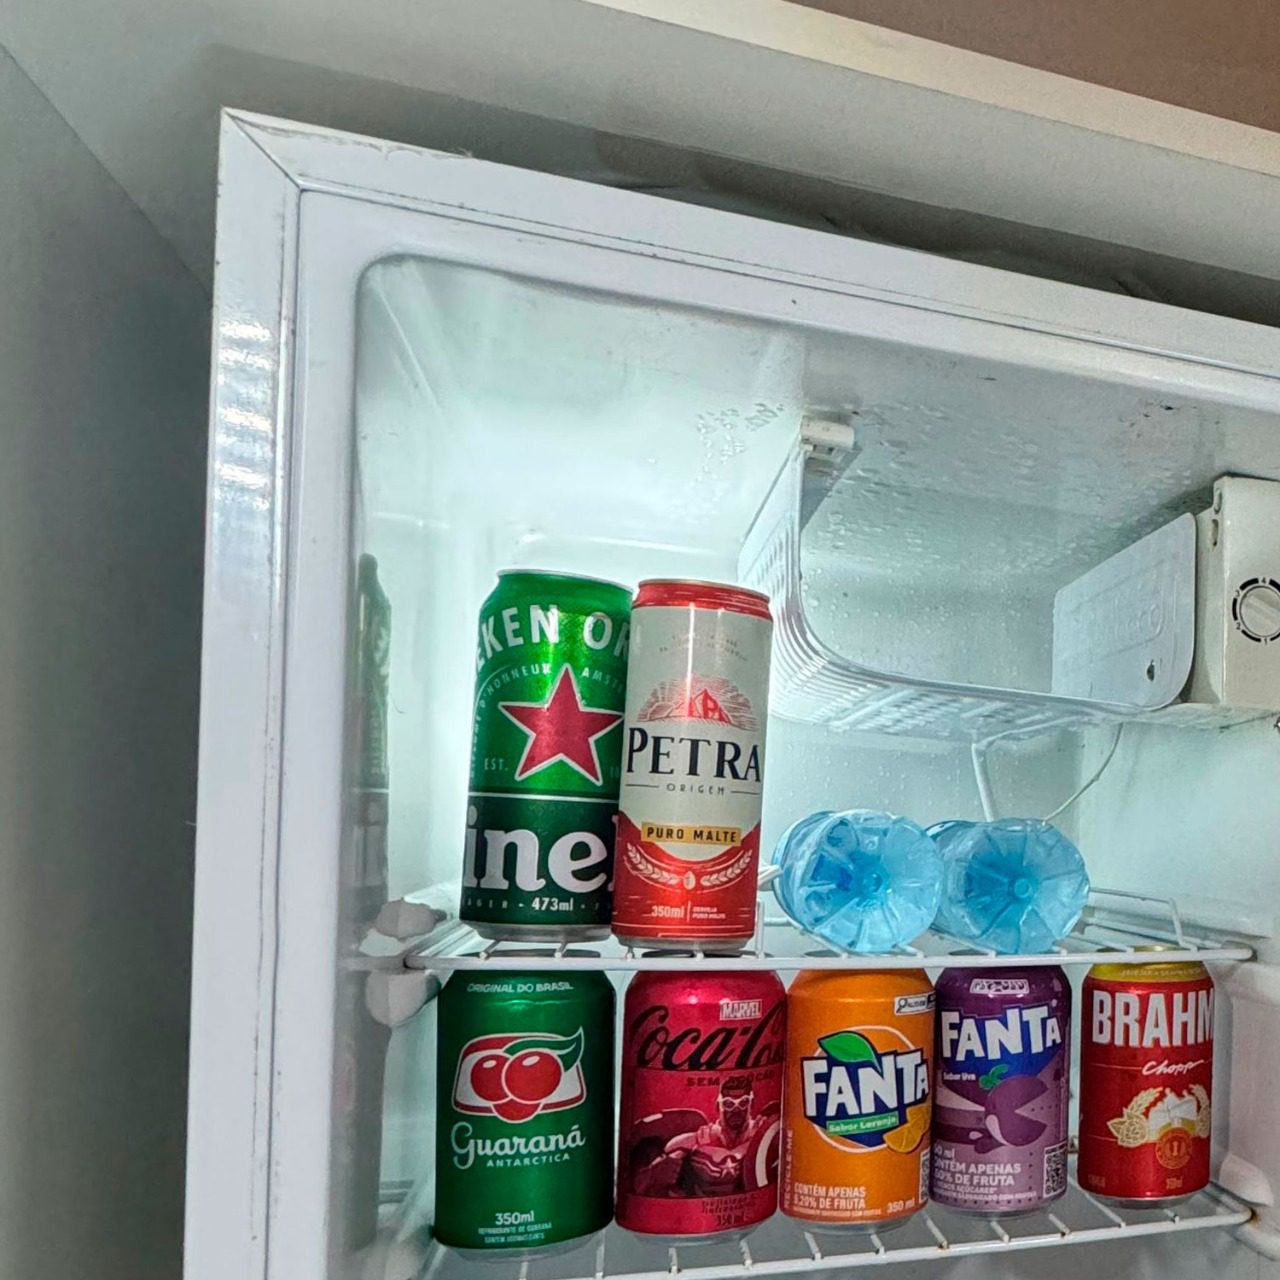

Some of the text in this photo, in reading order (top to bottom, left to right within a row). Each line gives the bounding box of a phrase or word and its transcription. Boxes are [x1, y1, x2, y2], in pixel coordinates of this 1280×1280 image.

[626, 727, 761, 783] PETRA
[484, 758, 509, 772] EST.
[666, 783, 725, 796] ORIGEM
[647, 827, 737, 842] PURO MALTE
[464, 805, 613, 893] ine
[531, 897, 574, 911] 473ml
[651, 905, 685, 918] 350ml
[467, 982, 575, 993] ORIGINAL DO BRASIL
[722, 1002, 761, 1018] MARVEL
[942, 1006, 1061, 1061] FANTA
[1142, 1060, 1204, 1075] Chopp
[686, 1076, 721, 1087] SEM
[803, 1051, 929, 1117] FANTA
[828, 1116, 898, 1133] Sabor Laranja
[451, 1121, 586, 1170] Guaraná
[486, 1153, 571, 1168] ANTARCTICA
[968, 1163, 1022, 1175] APENAS
[954, 1174, 971, 1185] DE
[973, 1175, 1015, 1186] FRUTA
[793, 1182, 866, 1197] CONTÉM APENAS
[819, 1198, 832, 1209] DE
[834, 1198, 866, 1209] FRUTA
[495, 1210, 535, 1225] 350ml
